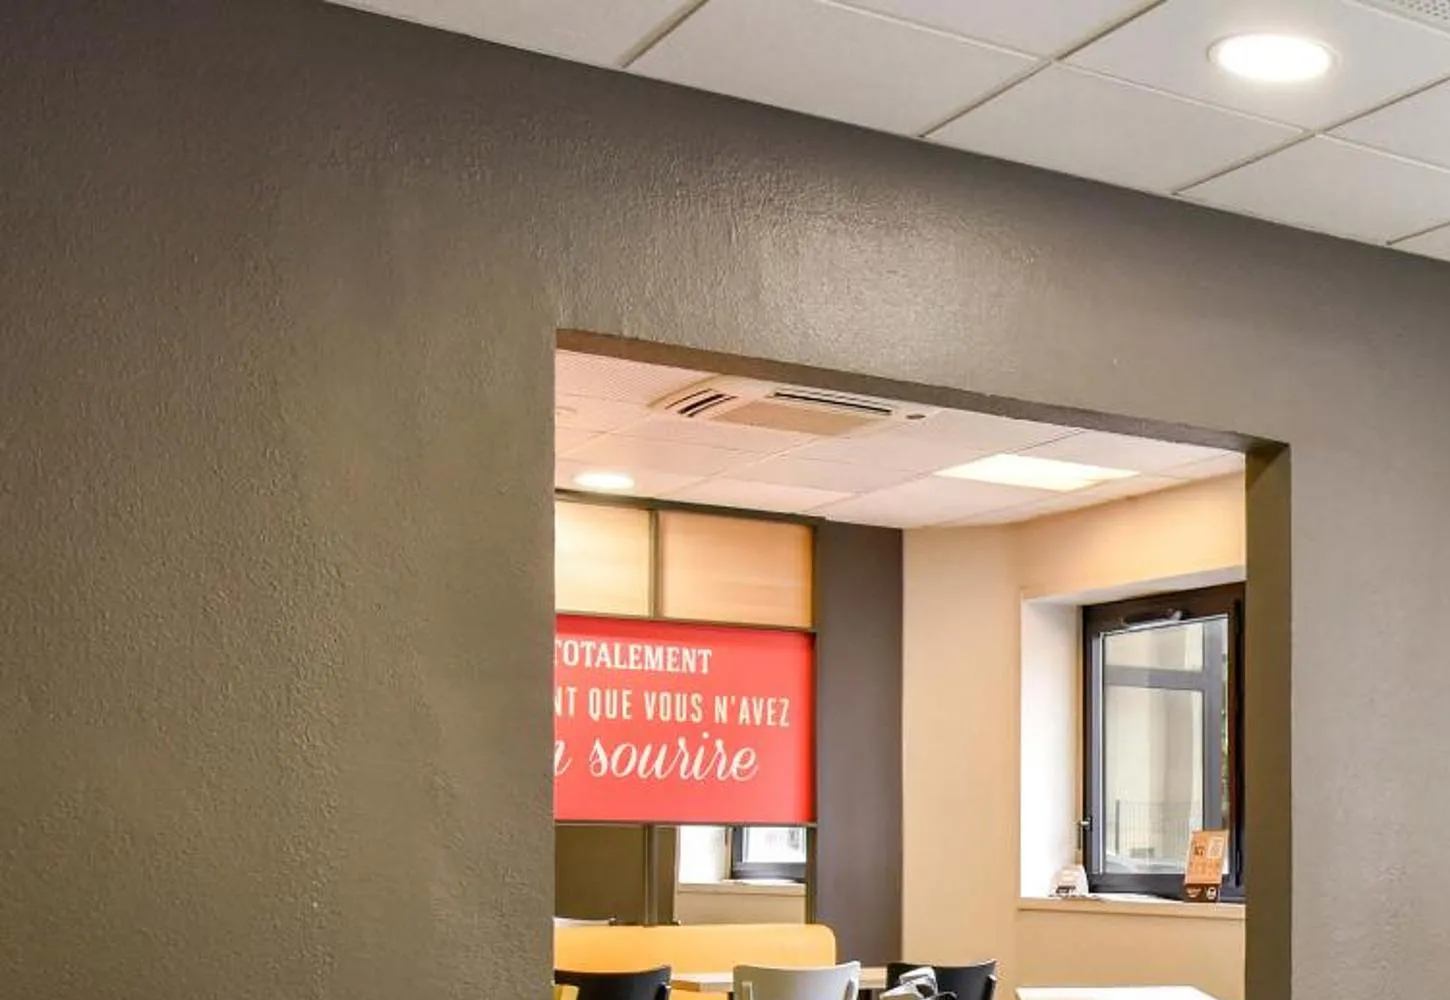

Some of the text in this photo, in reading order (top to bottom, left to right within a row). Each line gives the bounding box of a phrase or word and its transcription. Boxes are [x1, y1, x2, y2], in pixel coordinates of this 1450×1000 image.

[588, 687, 632, 721] QUE
[644, 691, 703, 723] VOUS
[715, 695, 790, 727] N'AVEZ
[588, 732, 759, 781] sourire
